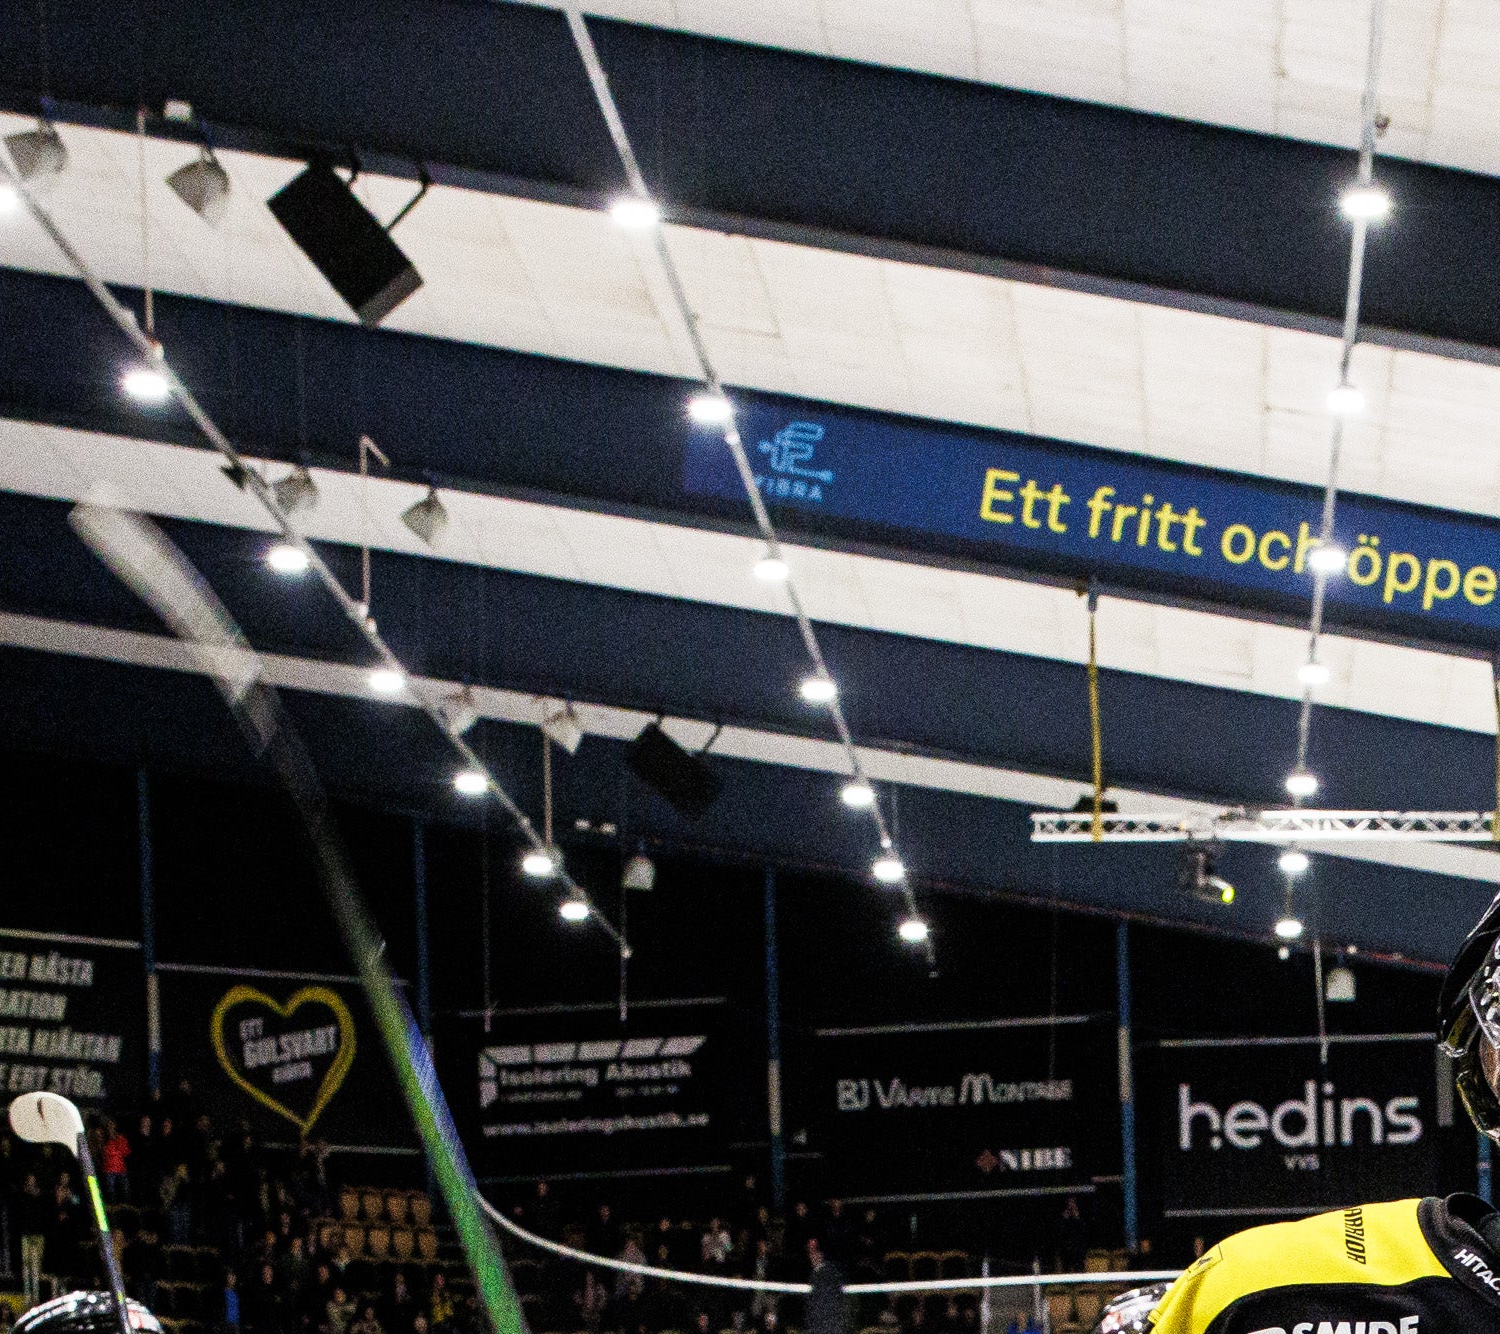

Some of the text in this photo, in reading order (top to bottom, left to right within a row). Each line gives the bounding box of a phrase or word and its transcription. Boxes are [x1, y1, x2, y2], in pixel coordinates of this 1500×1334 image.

[981, 468, 1068, 534] Ett
[1087, 487, 1206, 560] fritt
[1221, 516, 1315, 578] och
[1177, 1080, 1424, 1151] hedins
[1000, 1147, 1073, 1172] NIBE
